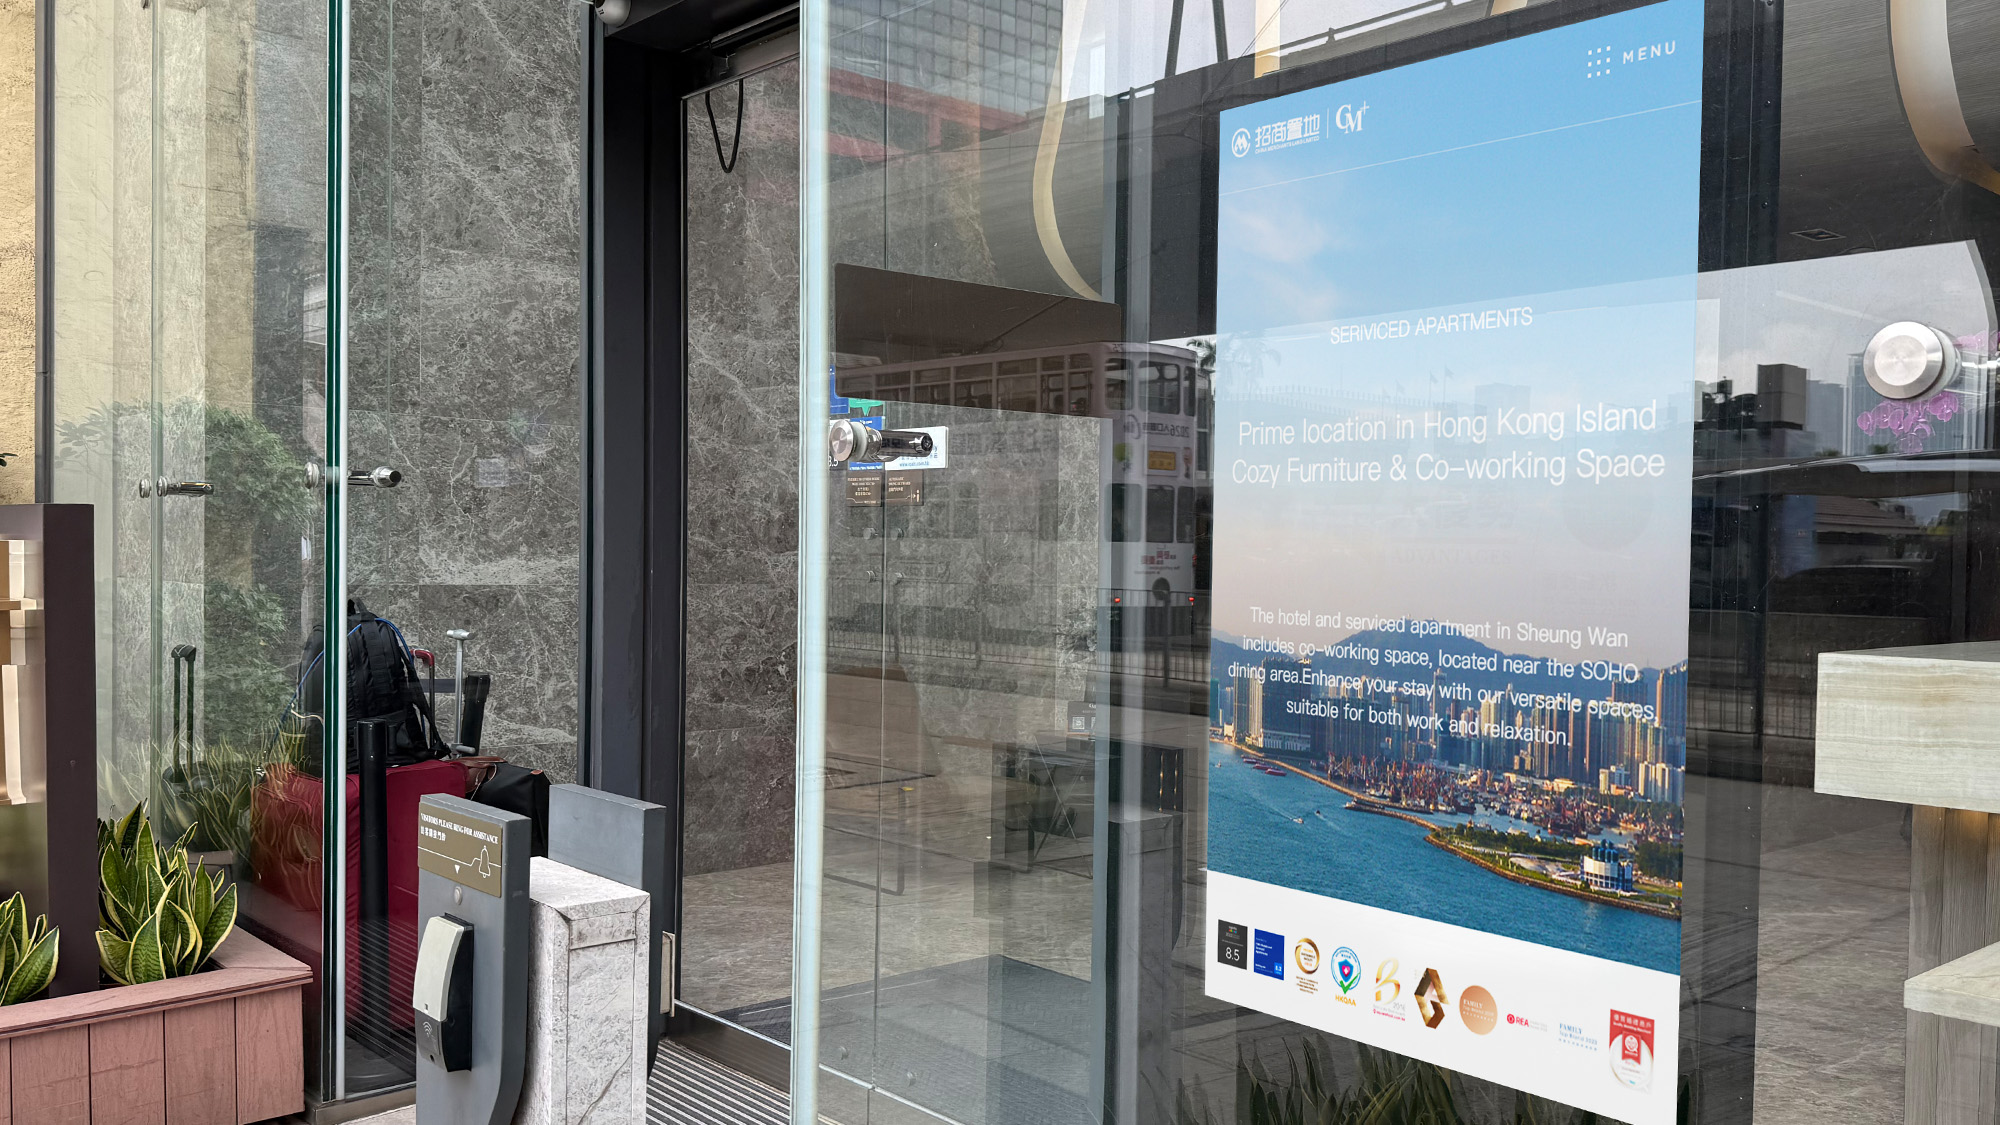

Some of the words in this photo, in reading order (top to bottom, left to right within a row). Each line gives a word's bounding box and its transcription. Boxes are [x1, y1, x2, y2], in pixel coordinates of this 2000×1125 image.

[1623, 40, 1676, 65] MENU
[1255, 114, 1319, 147] 招商置地
[1330, 320, 1410, 344] SERIVICED
[1414, 306, 1532, 335] APARTMENTS
[1239, 422, 1295, 445] Prime
[1303, 416, 1386, 443] location
[1397, 415, 1413, 439] in
[1425, 412, 1487, 443] Hong
[1498, 407, 1564, 440] Kong
[1576, 400, 1656, 433] Island
[1232, 460, 1279, 488] Cozy
[1288, 455, 1380, 483] Furniture
[1390, 454, 1407, 481] &
[1577, 448, 1665, 484] Space
[1250, 606, 1274, 625] The
[1278, 609, 1310, 627] hotel
[1315, 610, 1341, 628] and
[1346, 613, 1405, 633] serviced
[1410, 620, 1491, 639] apartment
[1497, 621, 1511, 639] in
[1517, 622, 1582, 649] Sheung
[1588, 626, 1628, 648] Wan
[1243, 635, 1294, 655] includes
[1300, 642, 1379, 666] co-working
[1384, 649, 1433, 669] space,
[1439, 649, 1498, 672] located
[1503, 658, 1540, 675] near
[1546, 658, 1574, 679] the
[1580, 660, 1638, 684] SOHO
[1228, 661, 1265, 684] dining
[1270, 667, 1361, 691] area.Enhance
[1366, 677, 1398, 696] your
[1403, 680, 1434, 701] stay
[1439, 681, 1472, 702] with
[1477, 688, 1505, 705] our
[1510, 691, 1583, 713] versatile
[1588, 699, 1659, 724] spaces,
[1286, 698, 1338, 719] suitable
[1343, 703, 1364, 722] for
[1369, 705, 1402, 726] both
[1407, 712, 1444, 732] work
[1449, 716, 1479, 736] and
[1484, 718, 1571, 746] relaxation.
[420, 813, 438, 825] VISITORS
[438, 818, 453, 830] PLEASE
[453, 823, 464, 834] RING
[463, 826, 473, 835] FOR
[473, 830, 499, 844] ASSISTANCE
[1225, 946, 1240, 962] 8.5
[1335, 994, 1357, 1007] HKQAA
[1516, 1016, 1530, 1028] REA
[1559, 1022, 1582, 1034] FAMILY
